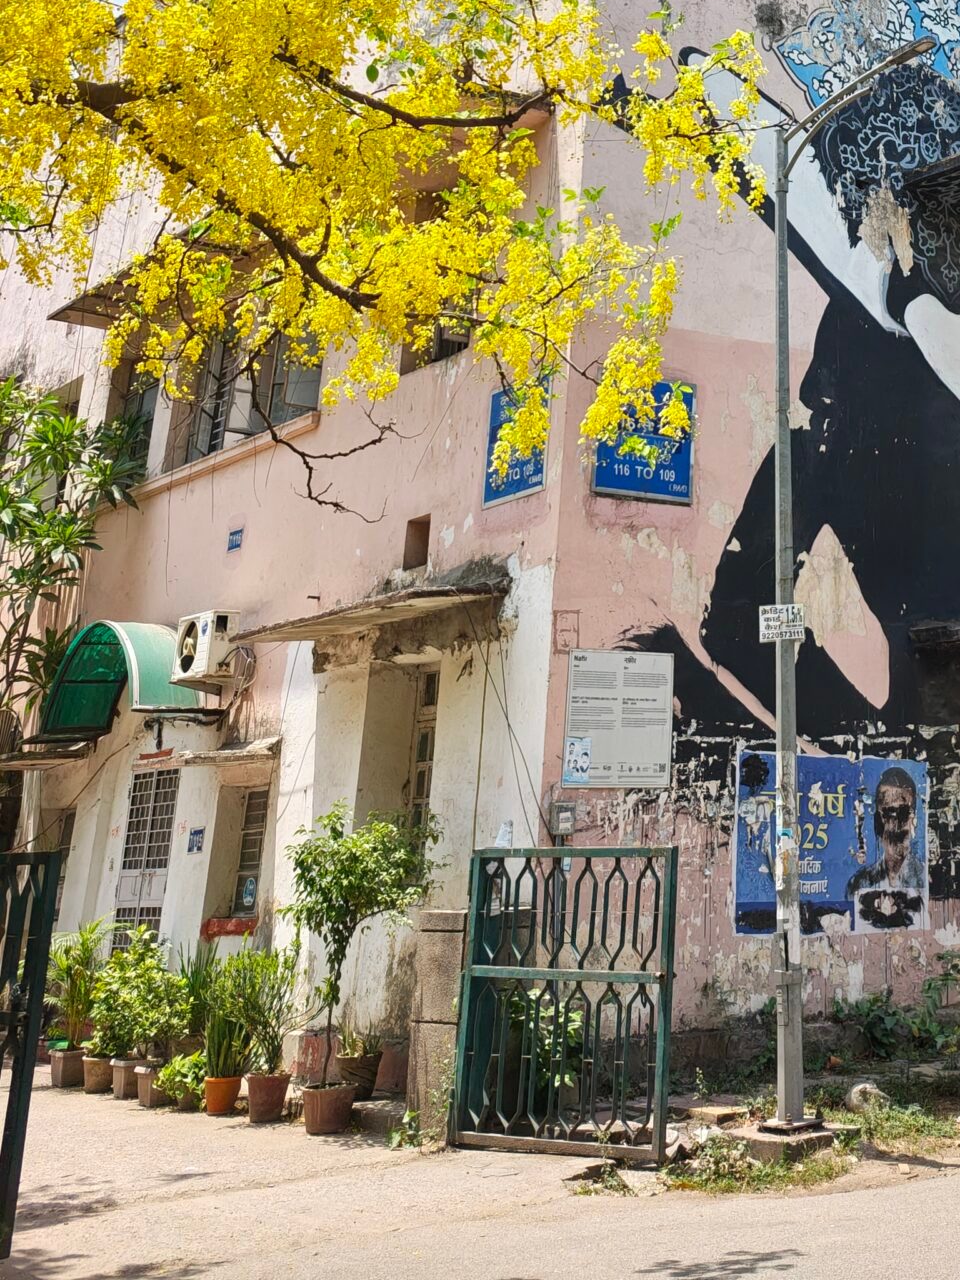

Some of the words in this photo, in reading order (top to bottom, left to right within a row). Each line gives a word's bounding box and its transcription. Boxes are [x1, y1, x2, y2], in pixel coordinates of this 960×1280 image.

[614, 464, 630, 476] 116
[635, 466, 653, 480] TO
[659, 469, 675, 481] 109
[761, 630, 804, 640] 9220573111
[799, 856, 822, 874] ार्दिक
